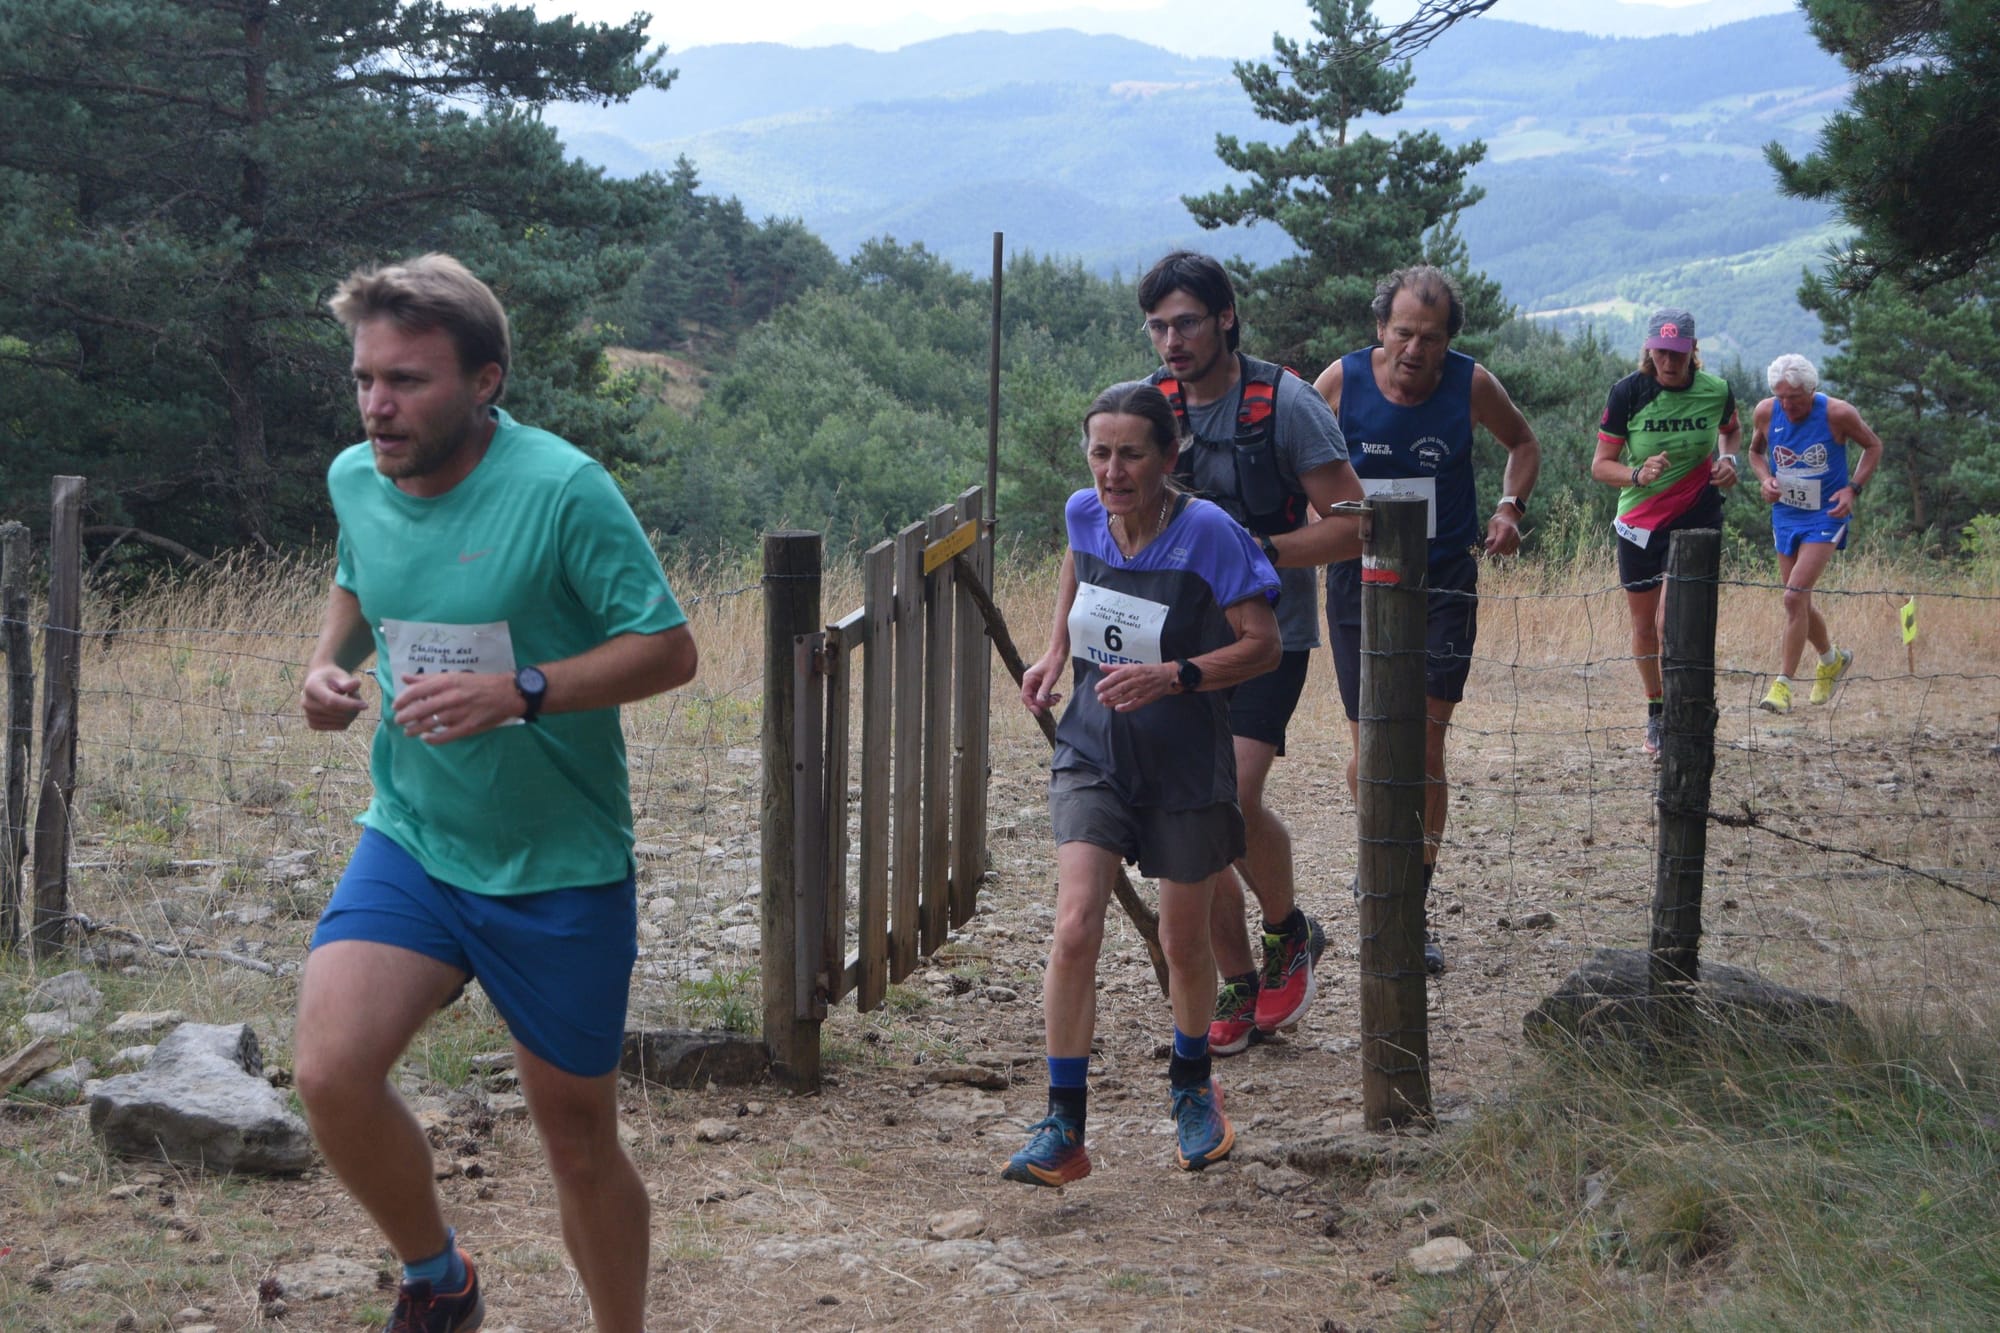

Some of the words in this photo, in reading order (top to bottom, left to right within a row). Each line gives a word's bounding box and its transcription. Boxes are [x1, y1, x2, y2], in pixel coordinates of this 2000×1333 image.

[1643, 417, 1708, 432] AATAC
[1788, 489, 1806, 502] 13
[1104, 625, 1123, 652] 6
